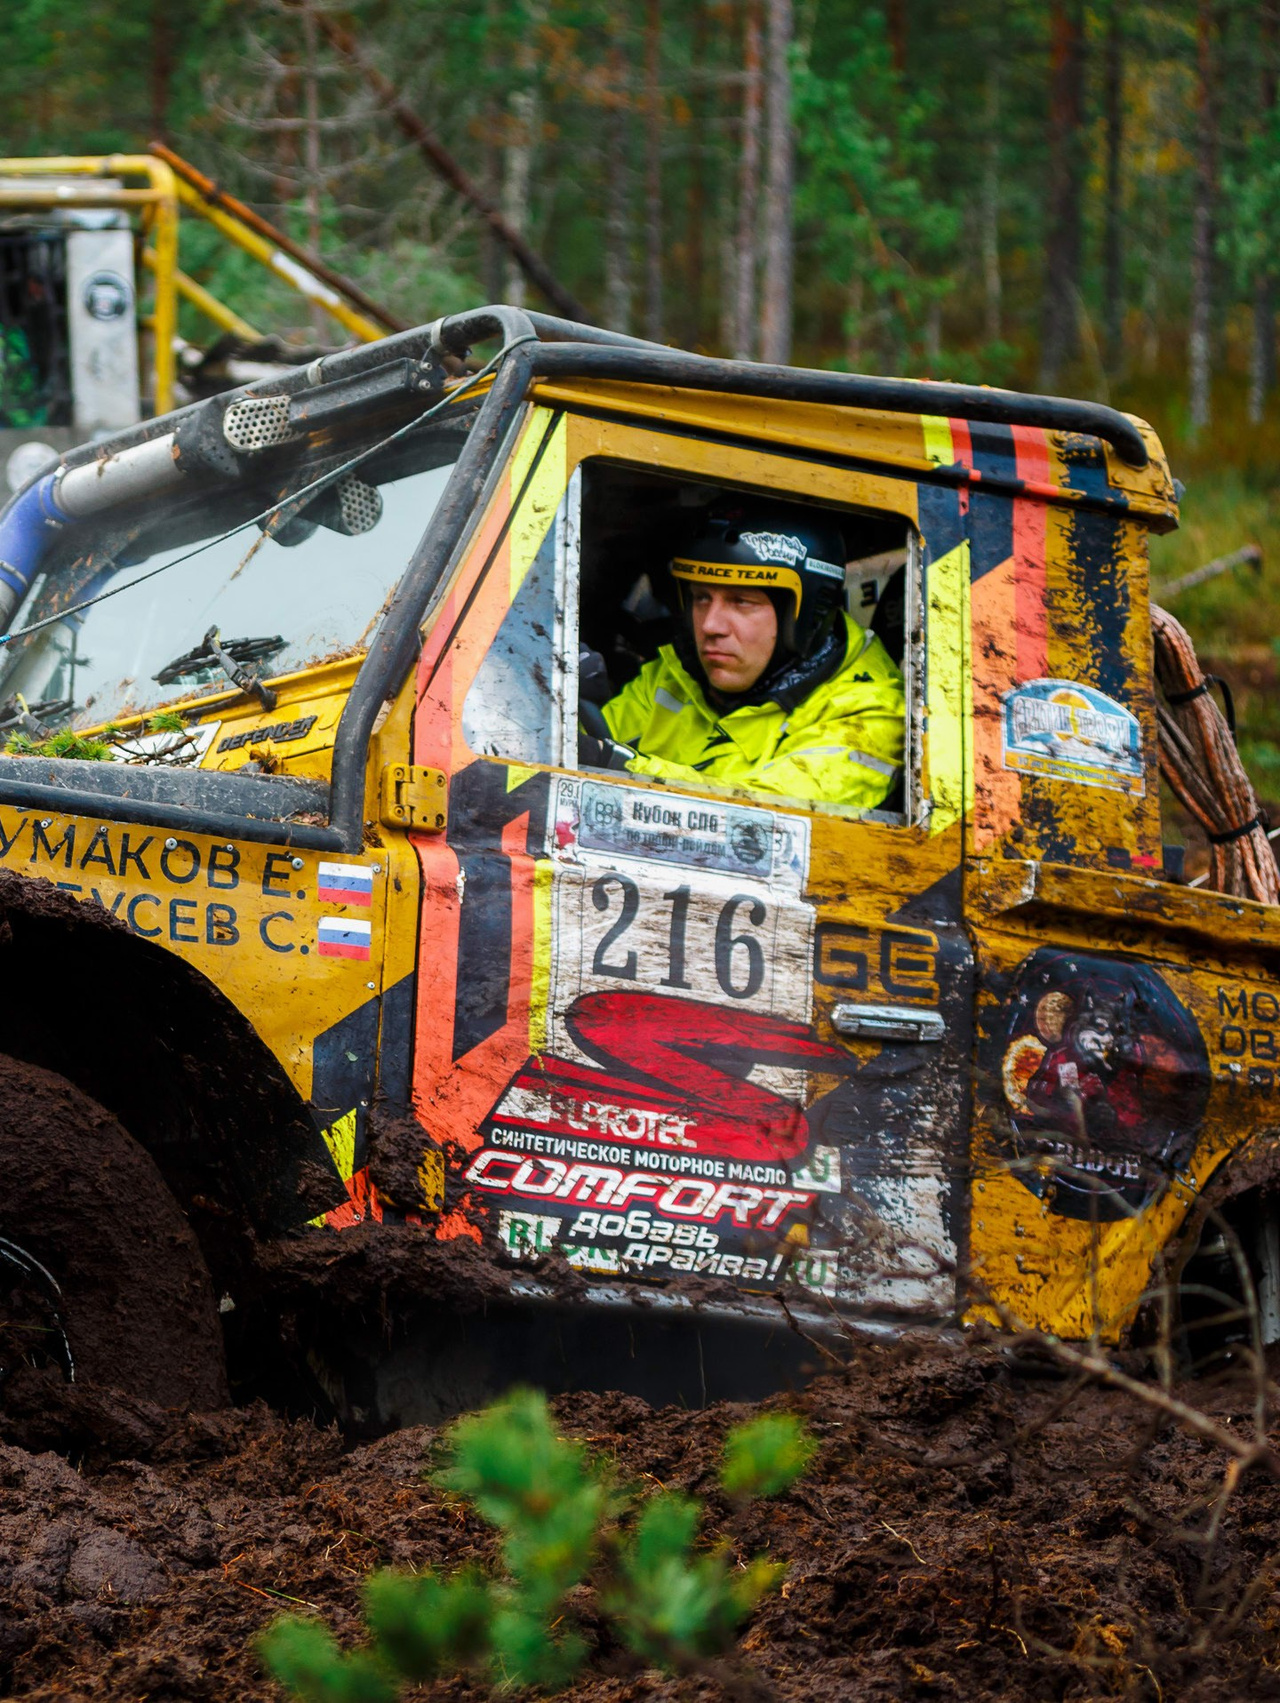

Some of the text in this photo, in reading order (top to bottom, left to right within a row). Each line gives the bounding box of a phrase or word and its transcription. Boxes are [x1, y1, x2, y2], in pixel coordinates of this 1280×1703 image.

[698, 565, 733, 578] RACE
[737, 569, 778, 581] TEAM
[217, 714, 319, 754] DEFENDER
[632, 801, 719, 833] Кубок СПб
[261, 852, 307, 900] Е.
[258, 909, 311, 956] С.
[590, 872, 769, 1000] 216
[491, 1127, 787, 1186] СИНТЕТИЧЕСКОЕ МОТОРНОЕ МАСЛО
[465, 1150, 810, 1226] COMFORT
[568, 1209, 720, 1249] добавь
[621, 1243, 785, 1281] драйва!
